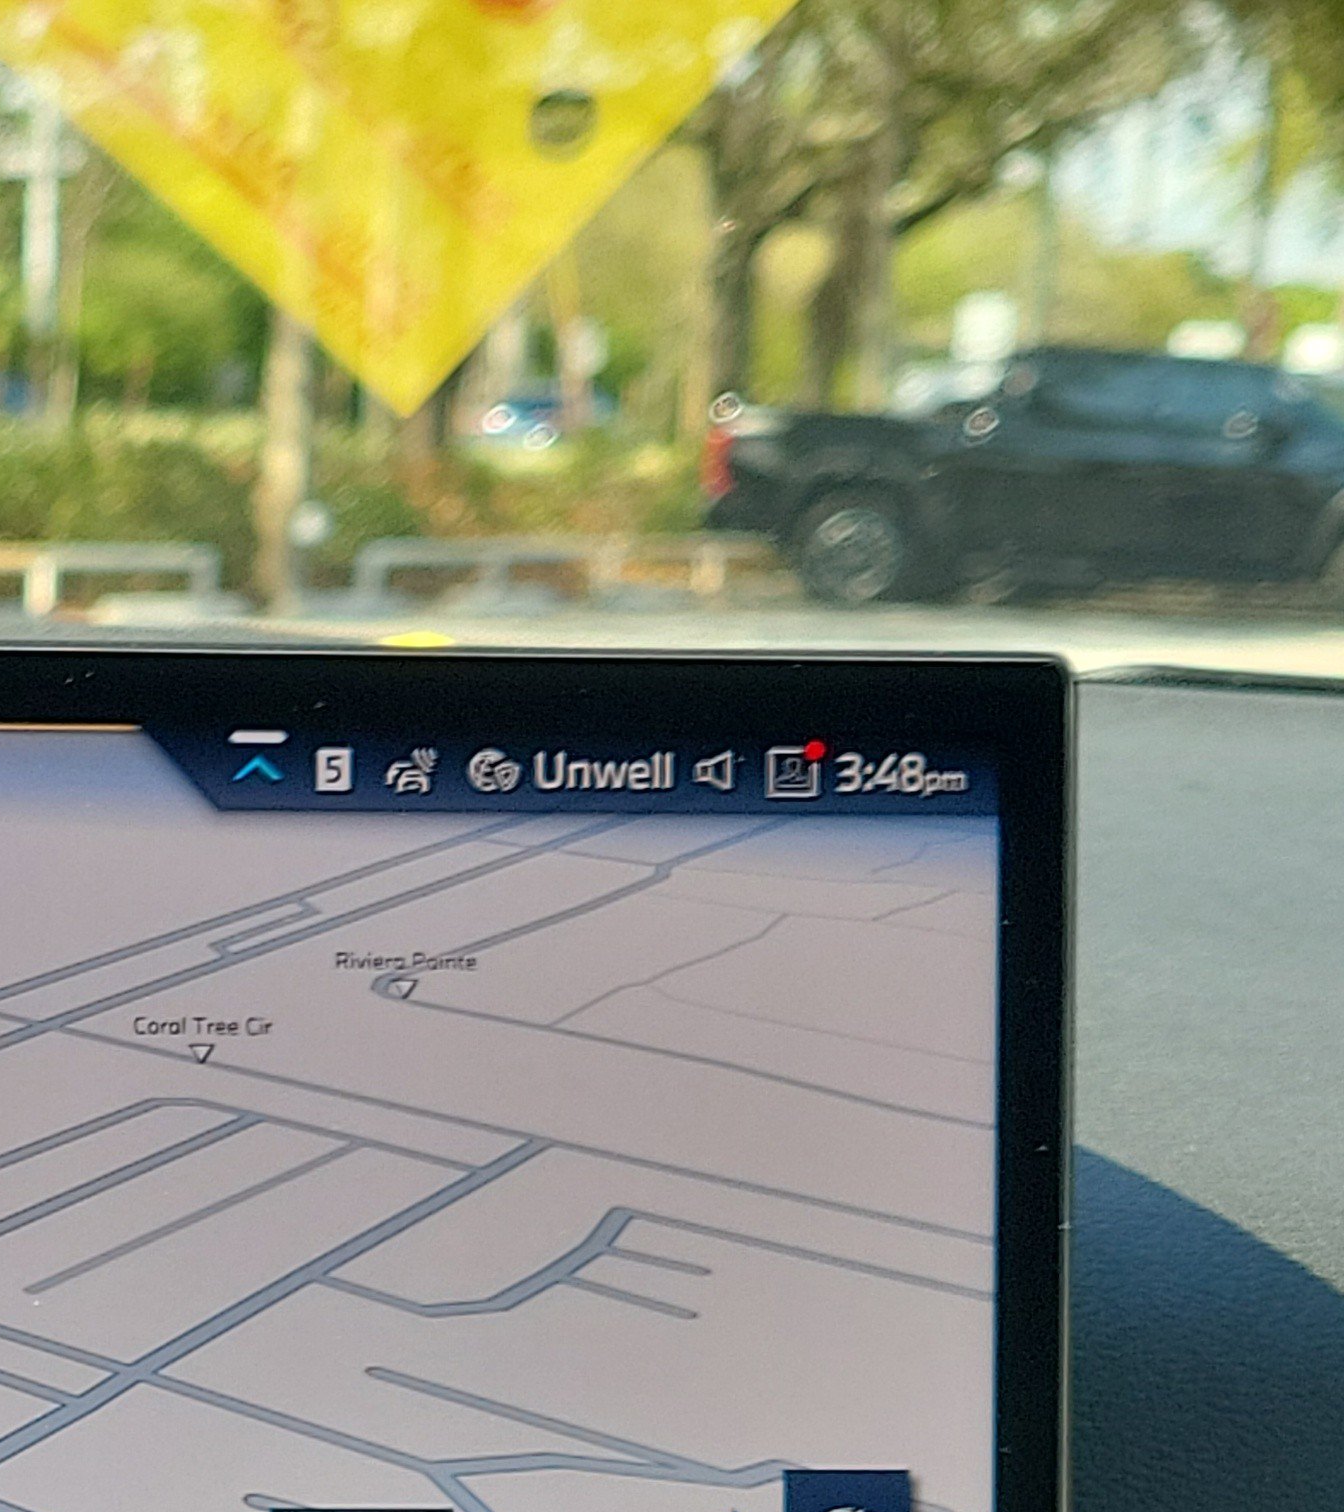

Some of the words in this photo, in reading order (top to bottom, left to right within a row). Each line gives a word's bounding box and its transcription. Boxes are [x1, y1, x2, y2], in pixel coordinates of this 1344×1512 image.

[533, 750, 675, 790] Unwell
[335, 952, 404, 970] Riviera
[133, 1016, 187, 1036] Coral
[194, 1016, 239, 1036] Tree
[245, 1016, 274, 1036] Cir
